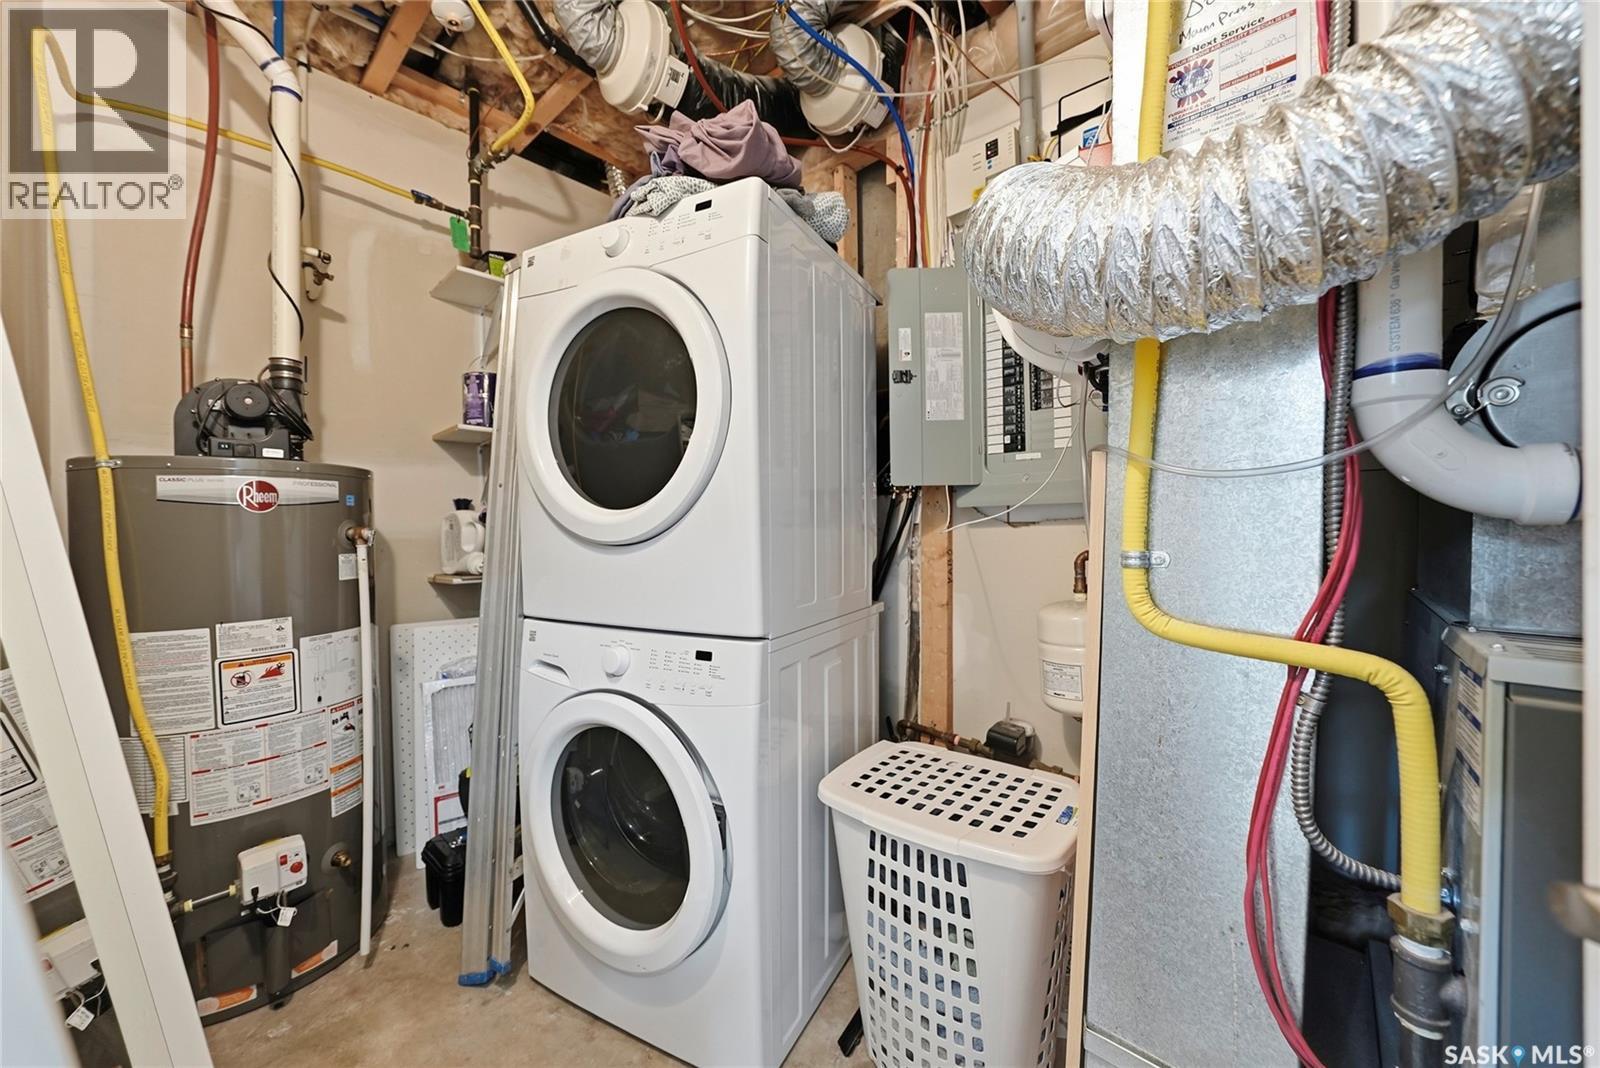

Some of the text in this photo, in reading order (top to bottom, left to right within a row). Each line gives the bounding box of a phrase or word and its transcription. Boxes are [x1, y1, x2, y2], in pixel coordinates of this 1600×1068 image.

[1192, 16, 1265, 53] Next Service
[1388, 315, 1401, 352] SYSTEM
[242, 480, 278, 507] Rheem
